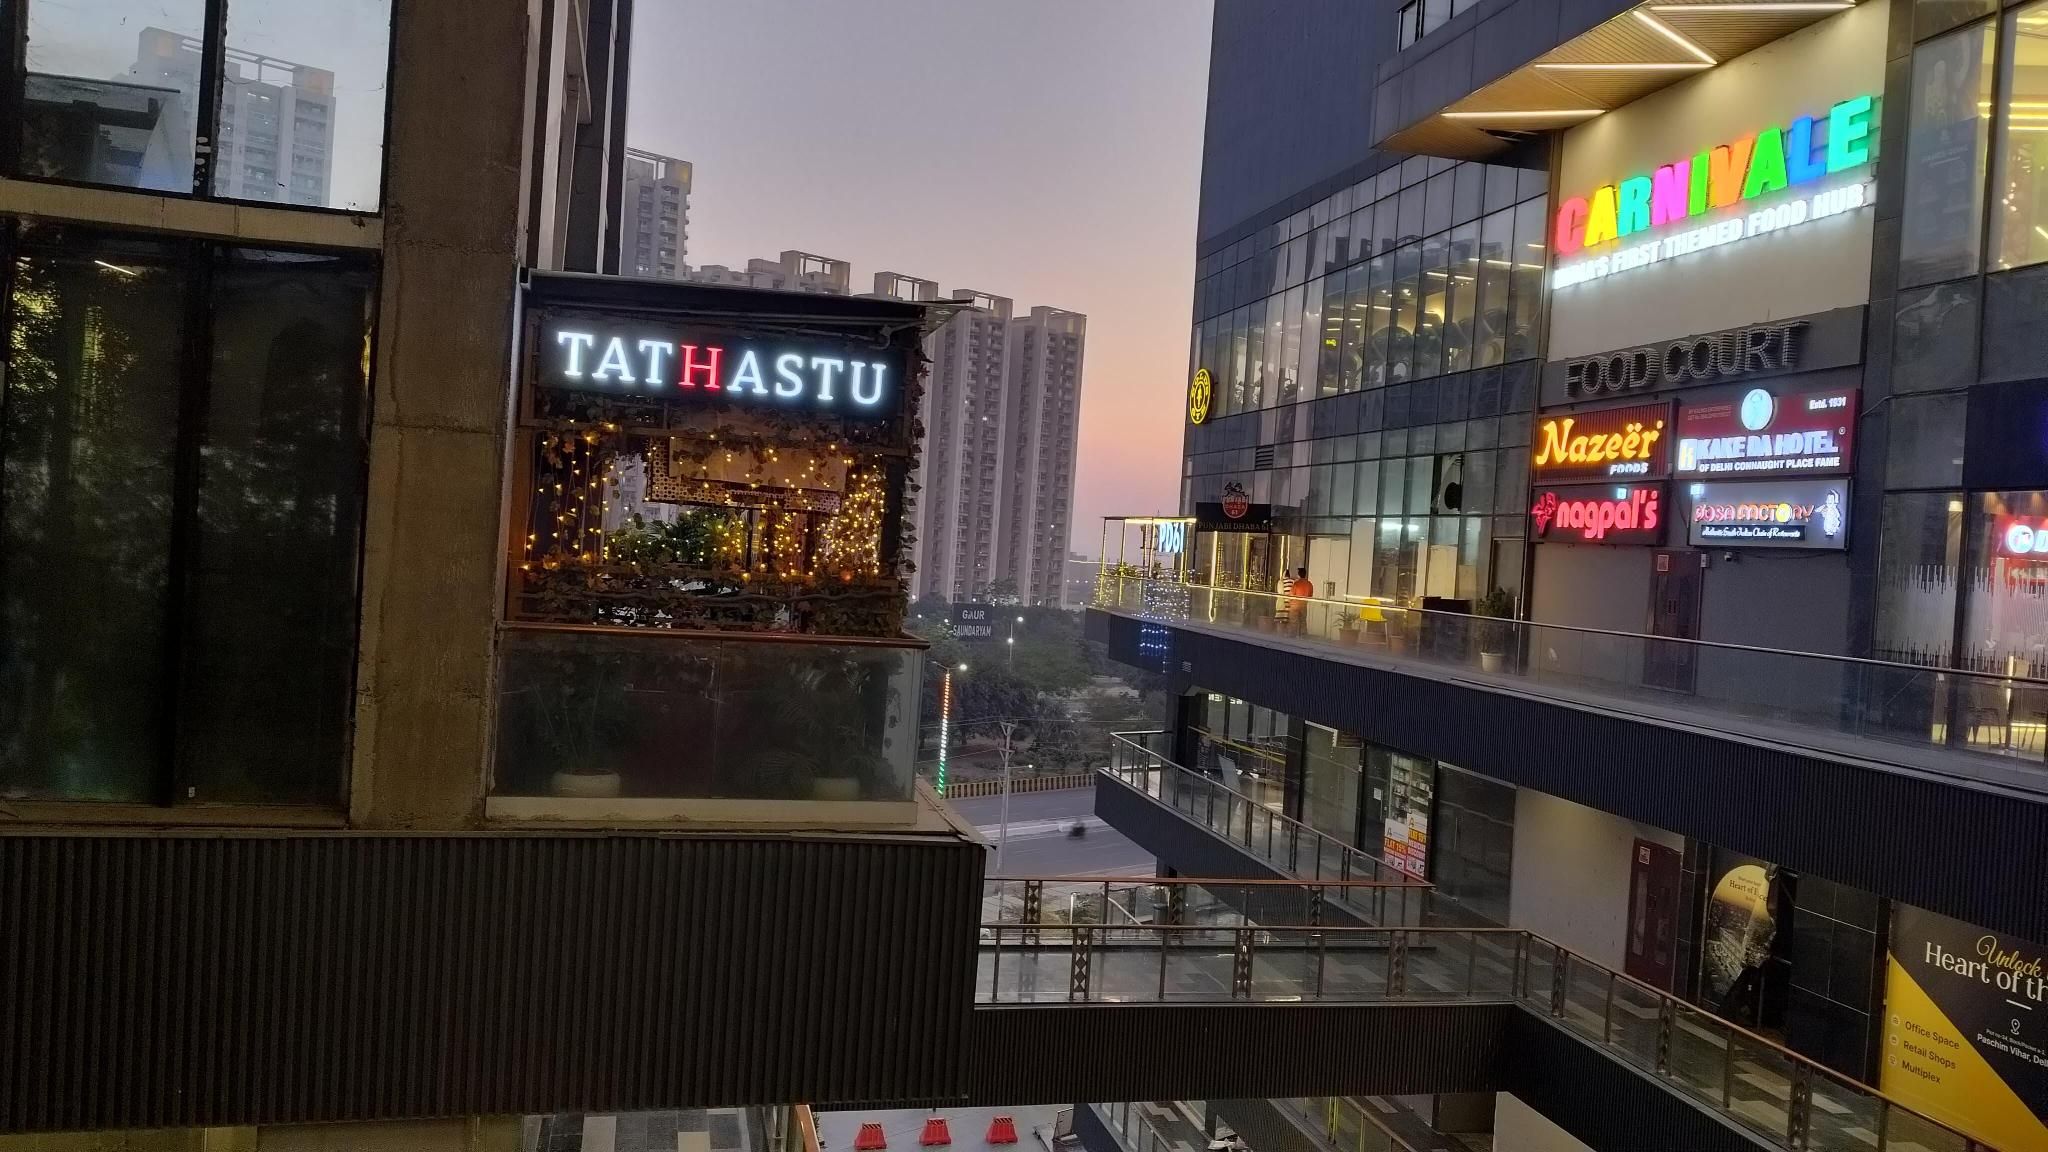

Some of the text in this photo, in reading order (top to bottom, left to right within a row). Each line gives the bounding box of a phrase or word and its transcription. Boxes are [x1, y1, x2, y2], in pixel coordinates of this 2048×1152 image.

[1556, 95, 1872, 255] CARNIVALE
[1611, 240, 1662, 274] FIRST
[1663, 217, 1744, 261] THEMED
[1748, 199, 1808, 237] FOOD
[1811, 182, 1865, 220] HUB
[557, 331, 887, 405] TATHASTU
[1565, 320, 1810, 398] FOOD COURT
[1697, 437, 1747, 460] KAKE
[1747, 434, 1773, 457] DA
[1775, 430, 1839, 456] HOTEL
[1609, 462, 1649, 475] FOODS
[1699, 456, 1840, 473] OF DELHI CONNAUGHT PLACE FAME
[1198, 520, 1232, 530] PUNJABI
[1232, 522, 1260, 531] DHABA
[1556, 489, 1658, 539] nagpal's
[1159, 521, 1185, 553] PD61
[962, 609, 985, 620] GAUR
[953, 624, 992, 637] SAUNDARYAM
[1729, 879, 1746, 892] Heart
[1925, 941, 1991, 984] Heart
[1996, 970, 2024, 993] of
[1976, 935, 2043, 977] Unlock
[1905, 1020, 1960, 1050] Office Space
[1977, 1033, 2009, 1052] Paschim
[2009, 1045, 2032, 1063] Vihar,
[1903, 1040, 1957, 1069] Retail Shops
[1901, 1059, 1941, 1084] Multiplex
